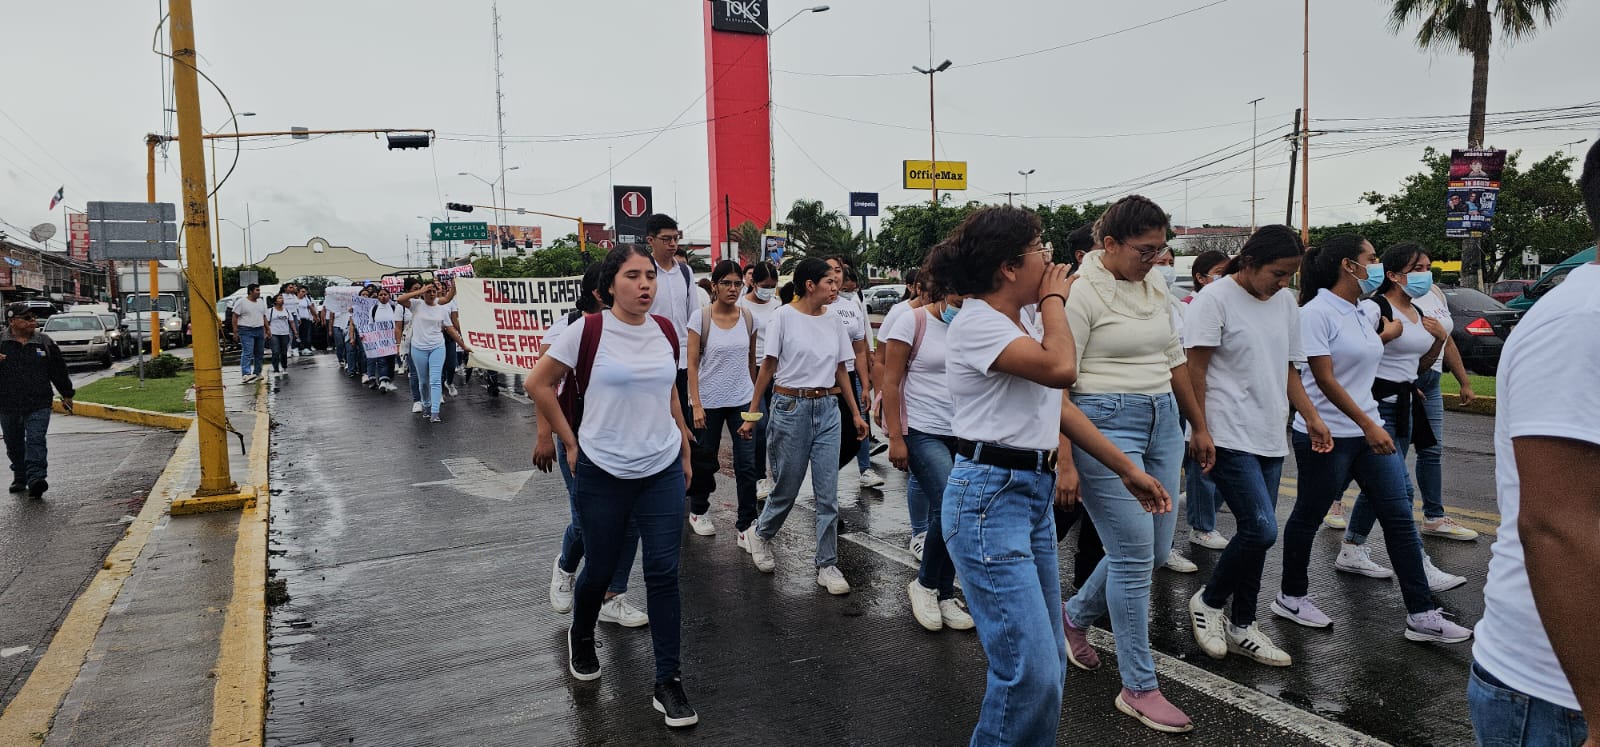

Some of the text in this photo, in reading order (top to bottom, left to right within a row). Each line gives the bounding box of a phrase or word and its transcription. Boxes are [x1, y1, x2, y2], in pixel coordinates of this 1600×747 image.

[909, 169, 964, 180] OfficeMax
[483, 280, 527, 304] SUBIO
[529, 281, 548, 304] LA
[494, 308, 539, 330] SUBIO
[468, 331, 497, 350] ESO
[497, 334, 518, 352] ES
